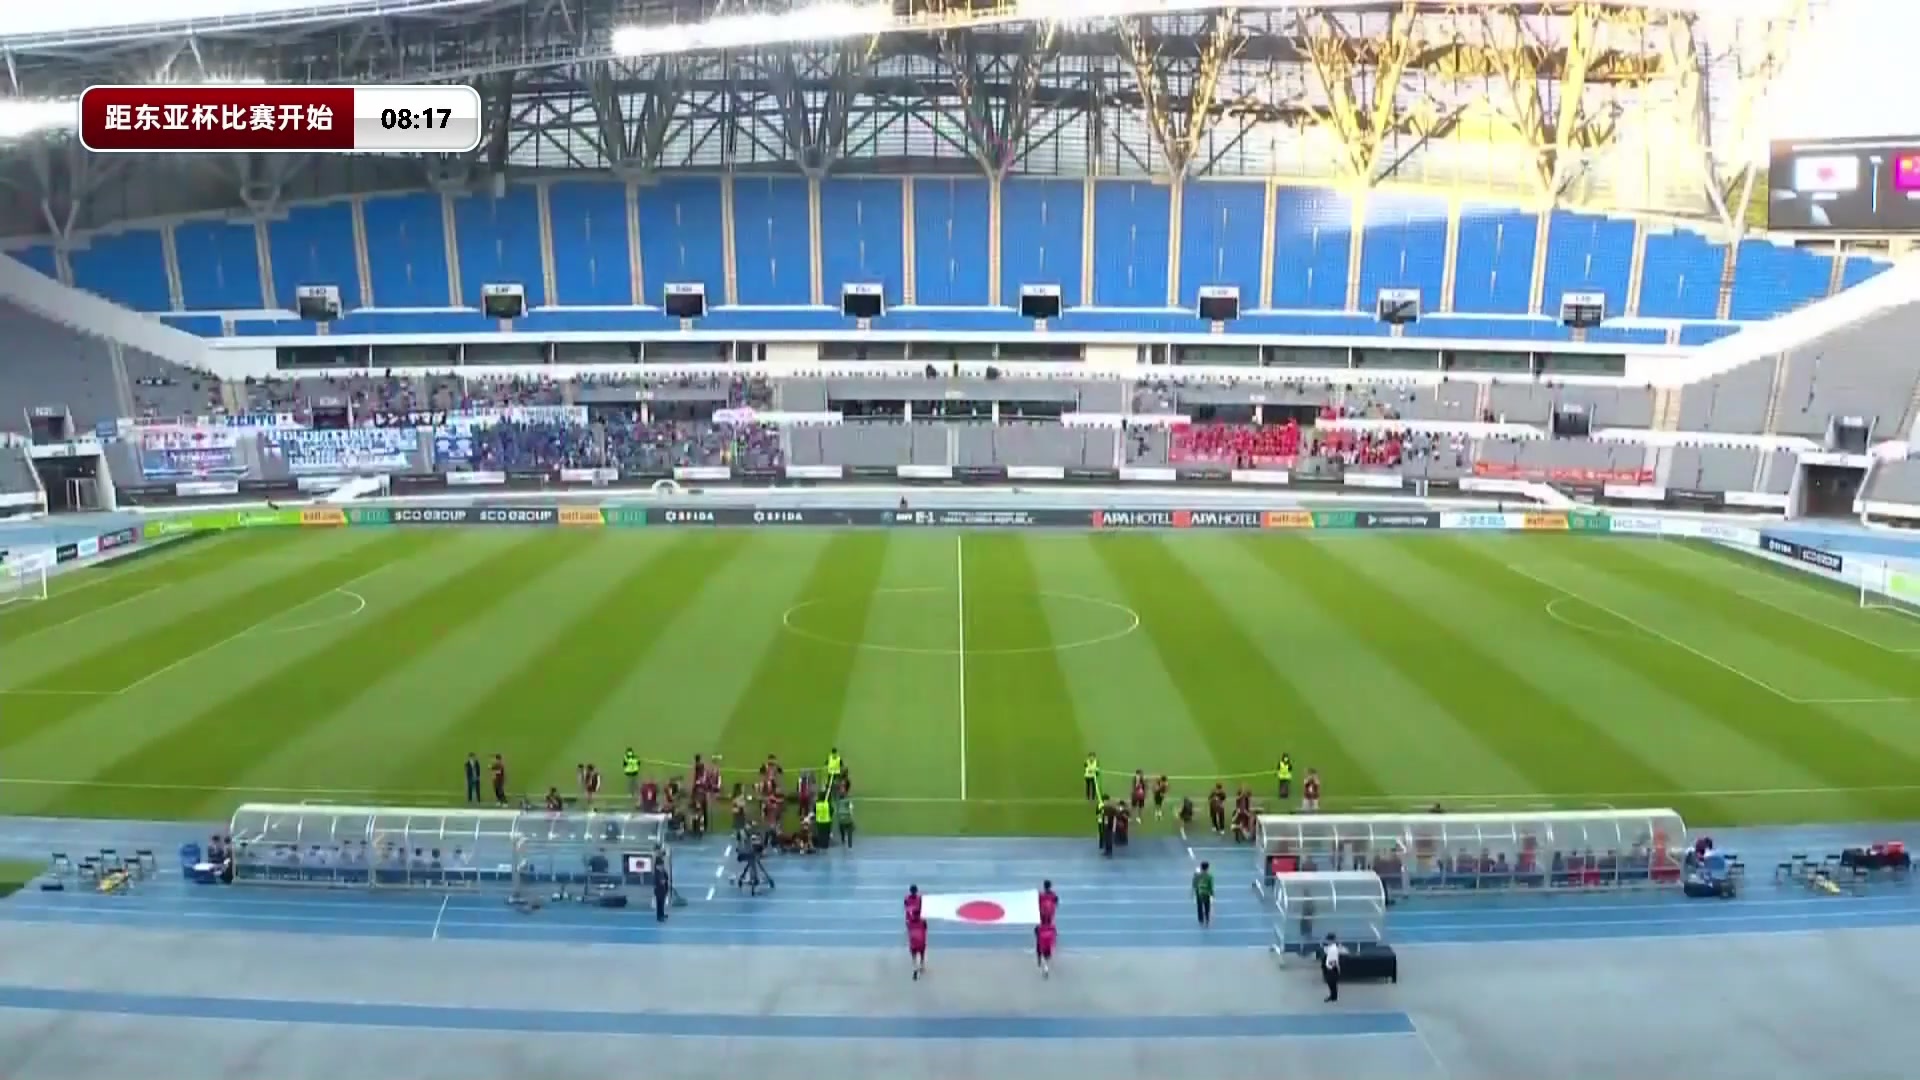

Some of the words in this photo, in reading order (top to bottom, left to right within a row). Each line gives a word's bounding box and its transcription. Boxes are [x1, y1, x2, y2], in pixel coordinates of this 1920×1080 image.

[423, 510, 466, 521] GROUP
[508, 510, 553, 521] GROUP
[1103, 511, 1129, 525] APA
[1130, 511, 1172, 525] HOTEL
[1191, 511, 1217, 525] APA
[1218, 511, 1260, 525] HOTEL
